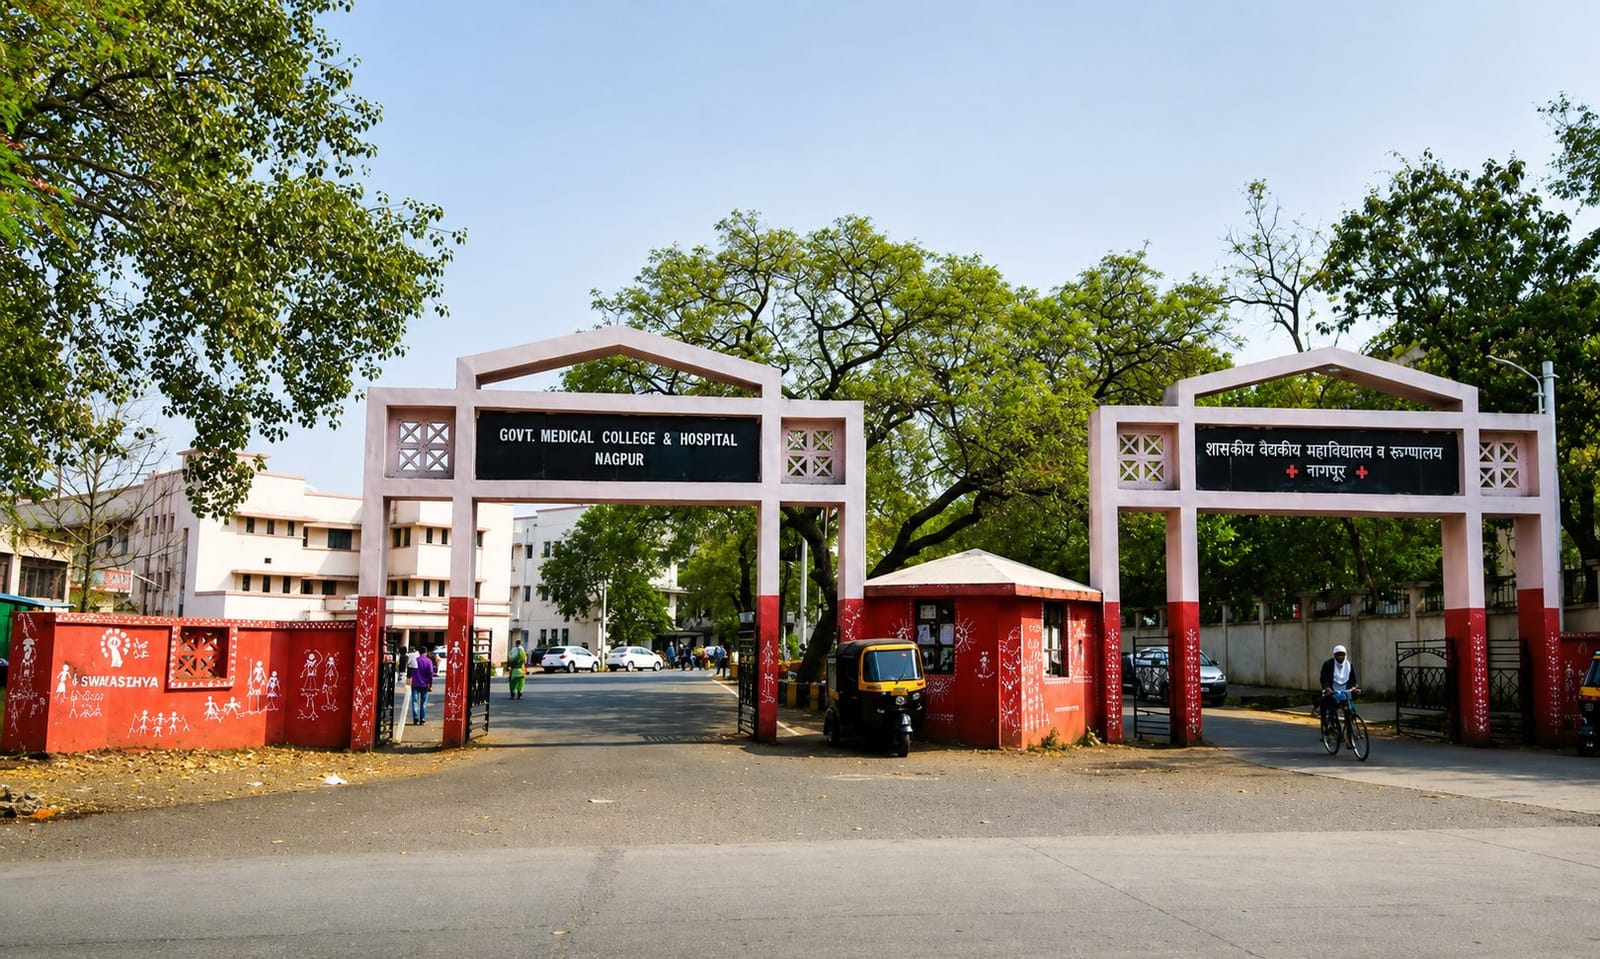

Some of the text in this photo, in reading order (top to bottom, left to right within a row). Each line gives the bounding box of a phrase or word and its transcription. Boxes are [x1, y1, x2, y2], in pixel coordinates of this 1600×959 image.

[499, 428, 738, 447] GOVT. MEDICAL COLLEGE & HOSPITAL
[1205, 439, 1255, 458] शासकीय
[1306, 440, 1374, 460] महाविद्यालय
[1376, 446, 1386, 459] व
[595, 452, 645, 466] NAGPUR
[1306, 464, 1347, 482] नागपूर
